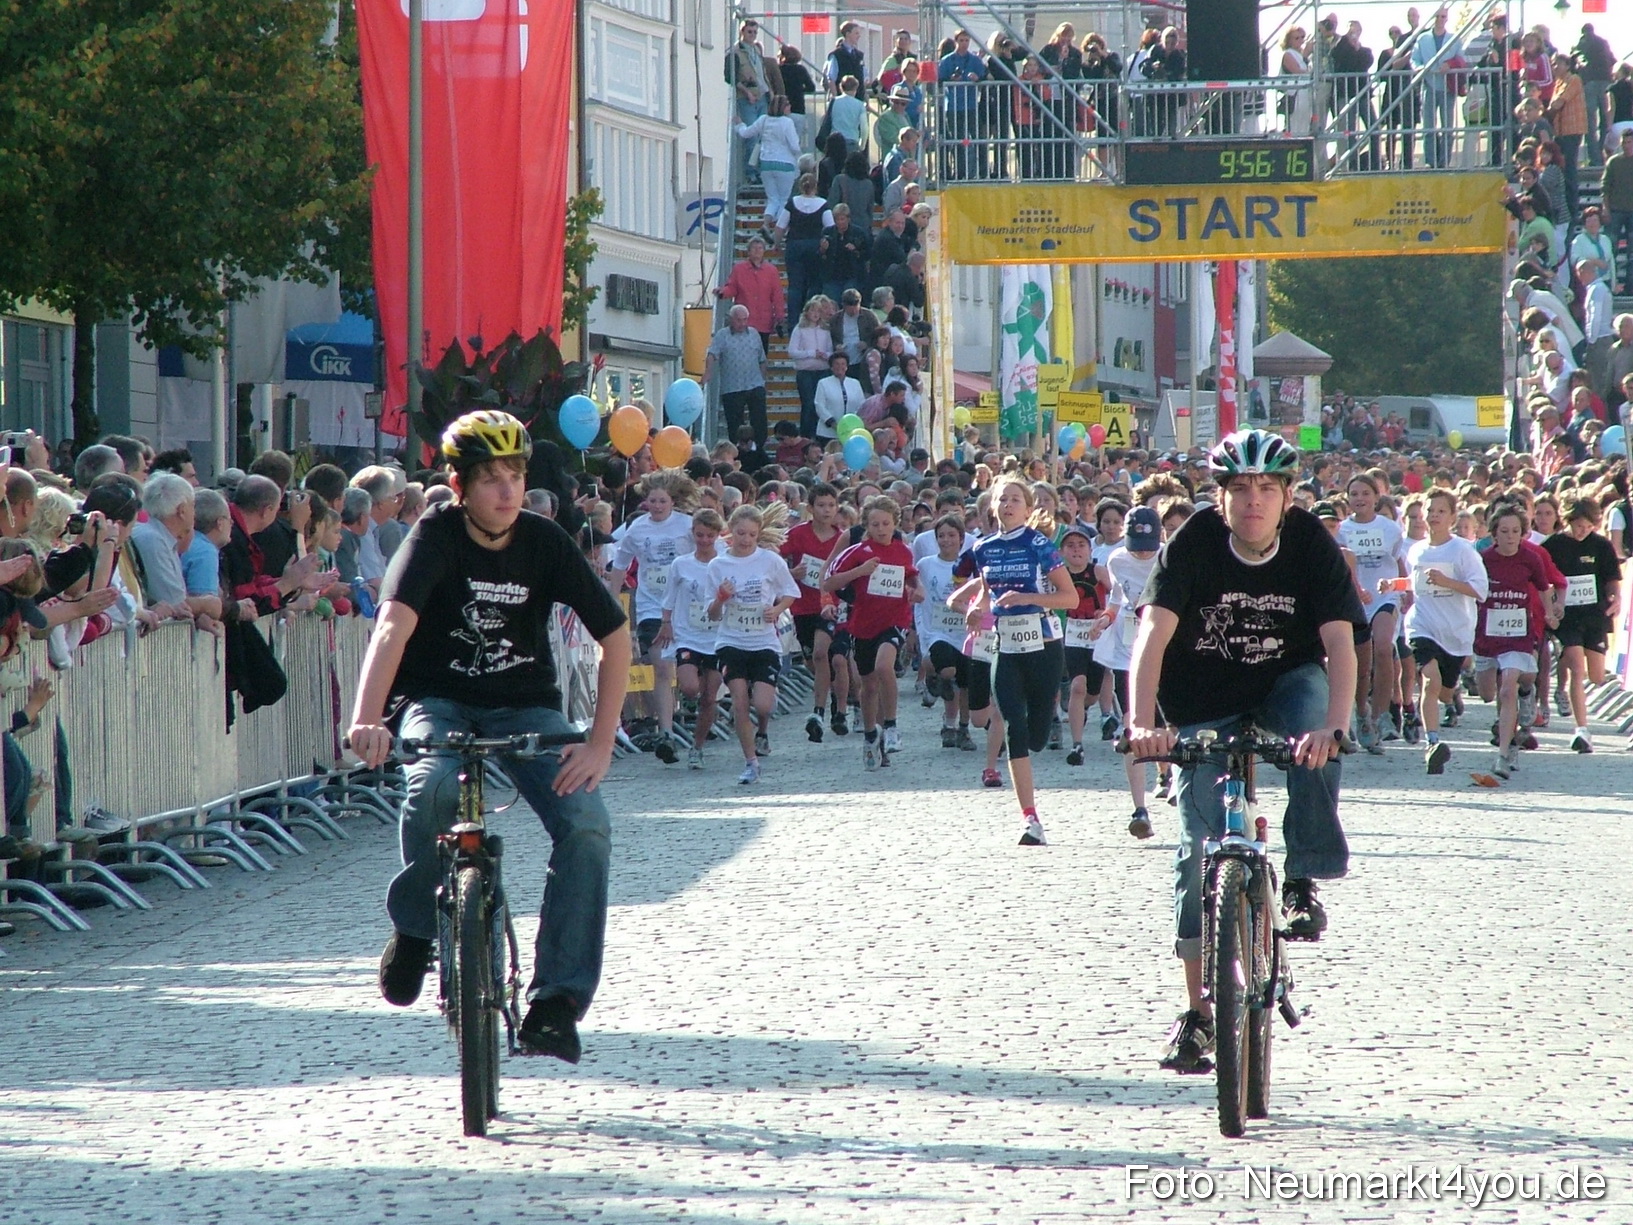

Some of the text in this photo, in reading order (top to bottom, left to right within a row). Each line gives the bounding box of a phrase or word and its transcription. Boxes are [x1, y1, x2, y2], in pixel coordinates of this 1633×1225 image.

[1128, 195, 1318, 242] START
[1352, 214, 1473, 227] Neumarkter Stadtlauf
[977, 224, 1095, 235] Neumarkter Stadtlauf
[1104, 406, 1127, 414] Block
[1107, 417, 1123, 438] A
[1358, 538, 1382, 547] 4013
[880, 579, 902, 589] 4049
[1571, 588, 1594, 597] 4106
[738, 616, 761, 625] 4111
[942, 617, 964, 625] 4021
[1007, 619, 1029, 627] Isabella
[1498, 619, 1523, 628] 4128
[1011, 630, 1038, 642] 4008
